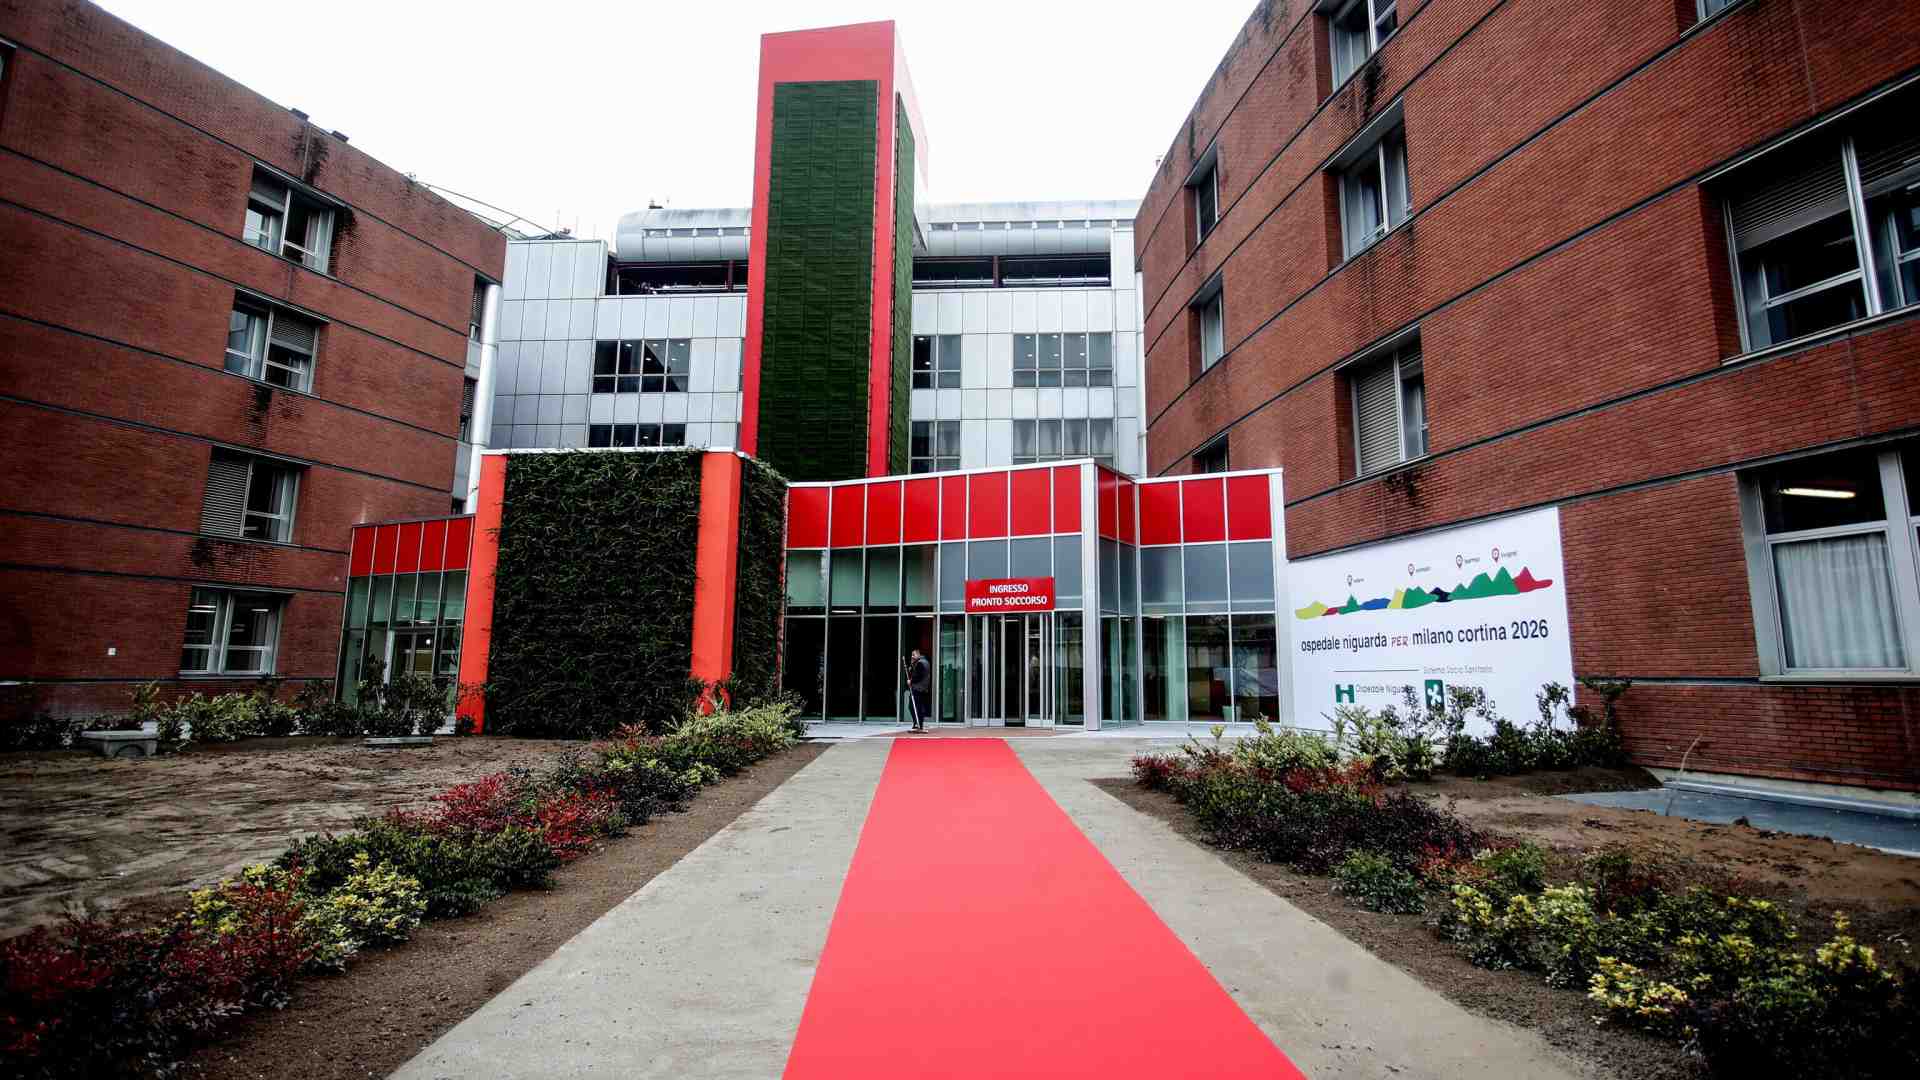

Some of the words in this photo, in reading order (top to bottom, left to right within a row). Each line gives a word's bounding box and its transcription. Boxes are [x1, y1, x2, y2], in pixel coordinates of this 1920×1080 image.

[989, 583, 1029, 594] INGRESSO
[971, 597, 1003, 608] PRONTO
[1004, 595, 1048, 606] SOCCORSO
[1301, 635, 1341, 655] ospedale
[1343, 632, 1388, 653] niguarda
[1412, 628, 1454, 645] milano
[1457, 624, 1507, 642] cortina
[1511, 619, 1549, 640] 2026
[1386, 684, 1417, 696] Nigua
